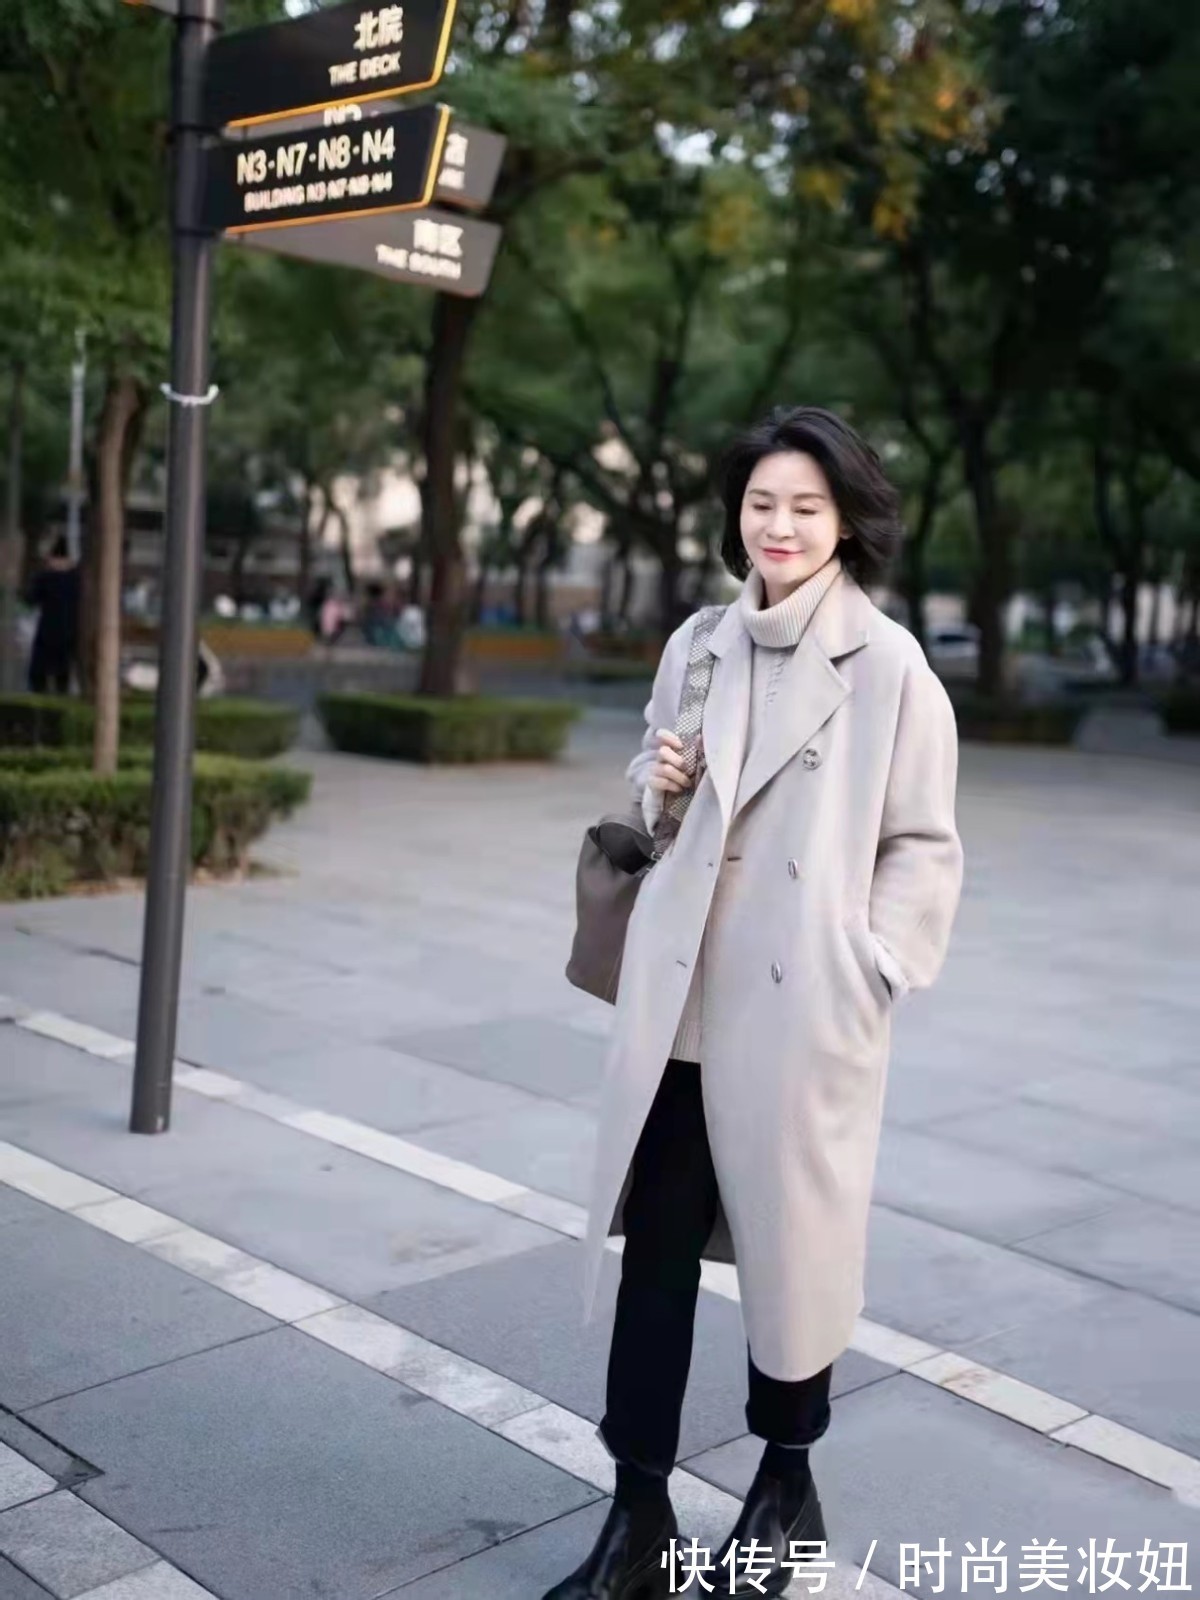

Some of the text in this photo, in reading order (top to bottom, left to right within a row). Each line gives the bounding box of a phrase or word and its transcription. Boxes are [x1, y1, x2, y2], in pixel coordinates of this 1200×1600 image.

[328, 51, 401, 86] THE DECK
[244, 184, 305, 212] BUILDING
